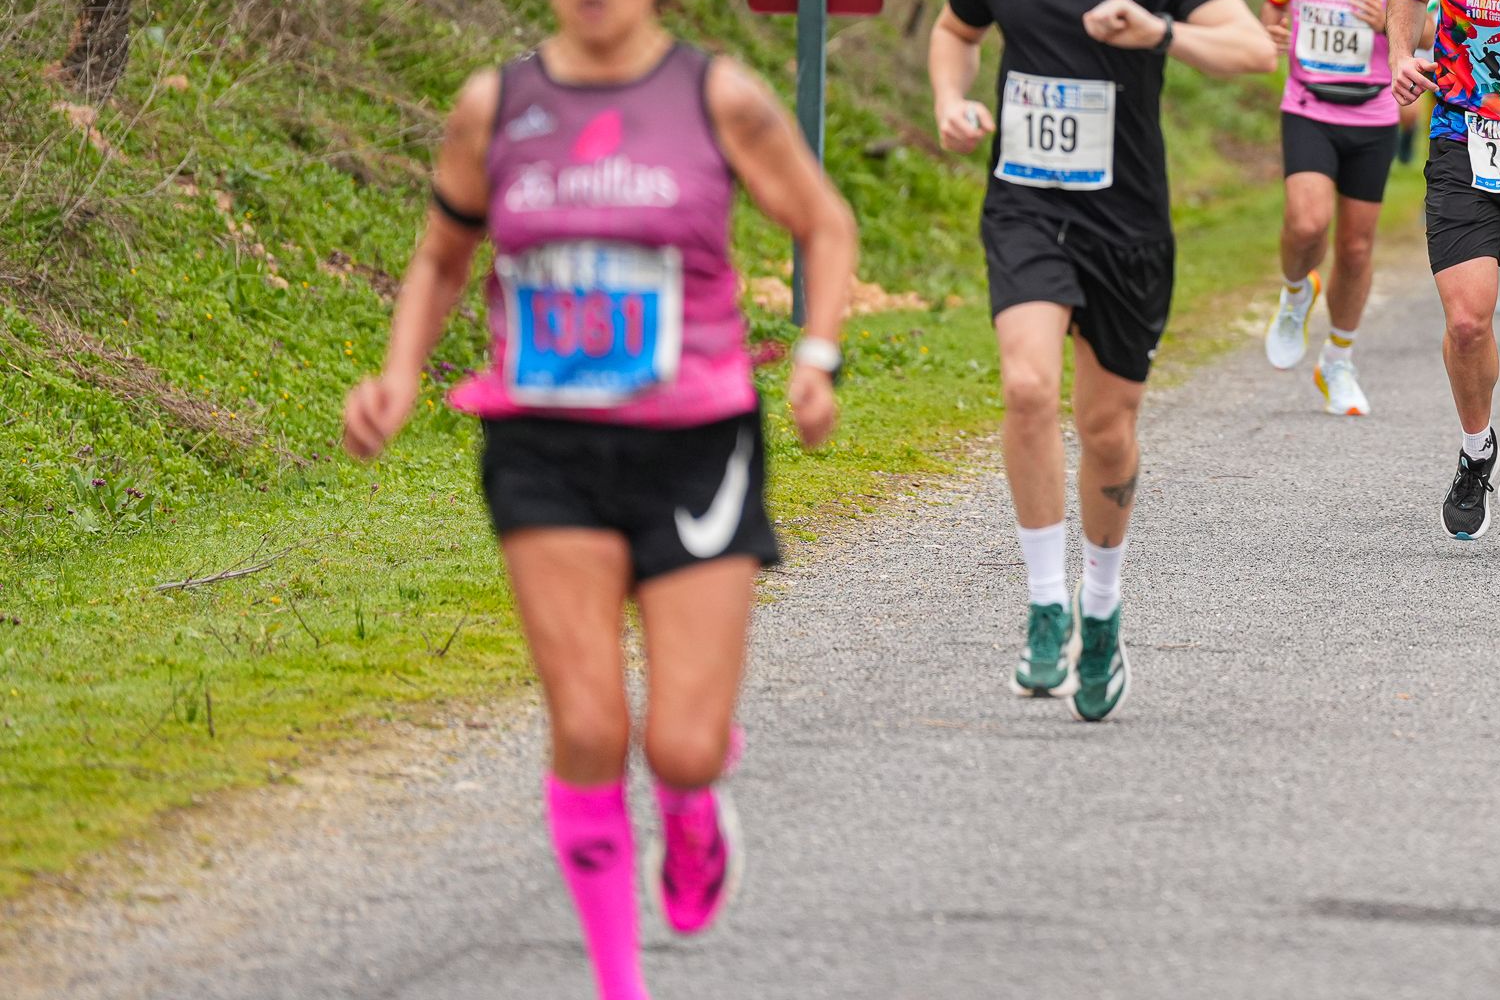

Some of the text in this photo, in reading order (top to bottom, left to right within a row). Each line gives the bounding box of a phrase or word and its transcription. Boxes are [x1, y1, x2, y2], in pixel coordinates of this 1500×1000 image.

[1472, 9, 1489, 20] 10K
[1310, 28, 1358, 53] 1184
[1025, 113, 1077, 152] 169
